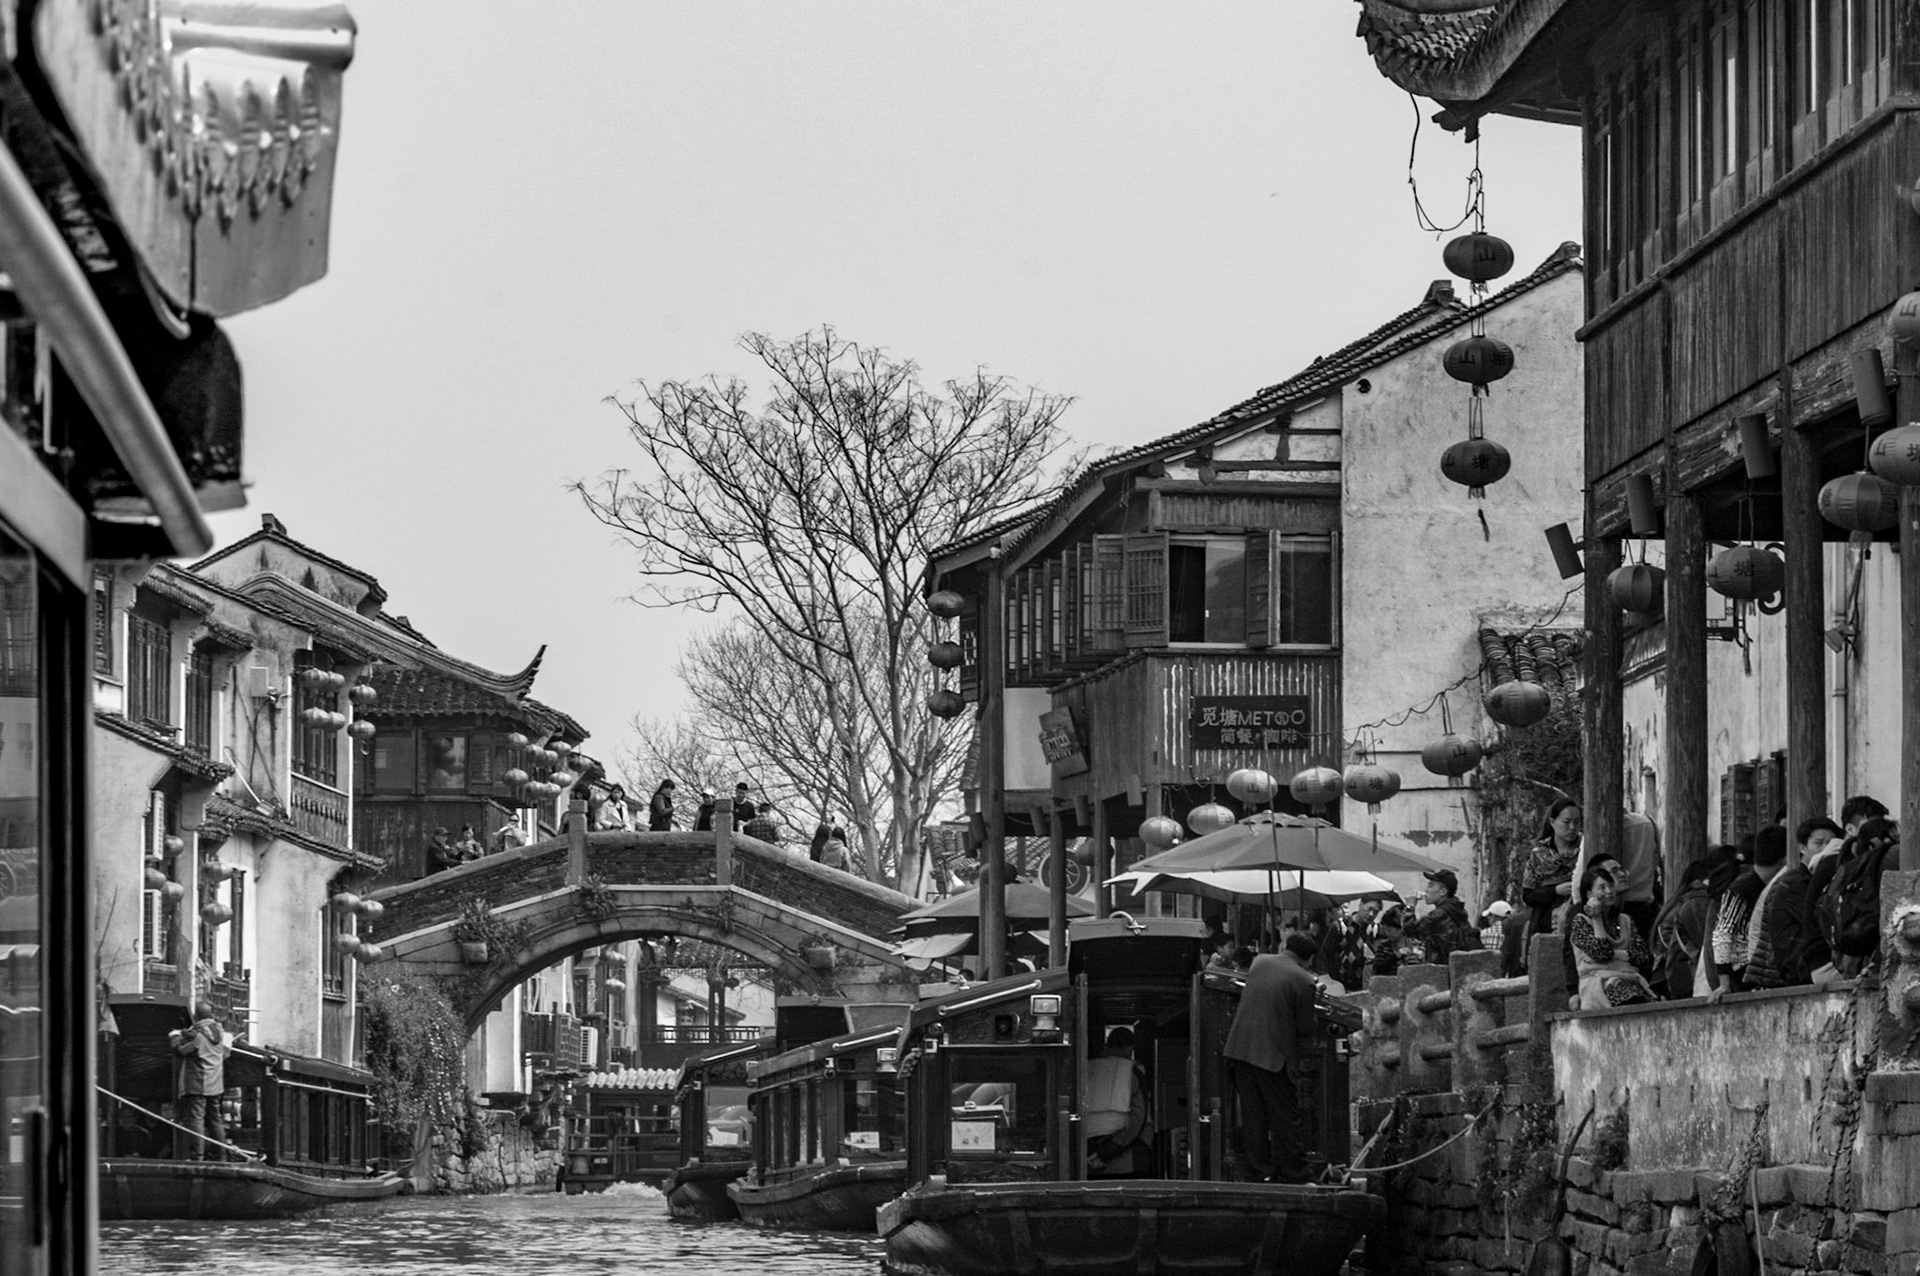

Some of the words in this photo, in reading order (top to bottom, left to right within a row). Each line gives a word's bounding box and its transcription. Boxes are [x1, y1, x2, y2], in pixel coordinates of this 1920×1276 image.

[1479, 247, 1496, 262] 山
[1899, 299, 1918, 317] 山
[1453, 744, 1468, 757] 山
[1247, 783, 1260, 794] 山
